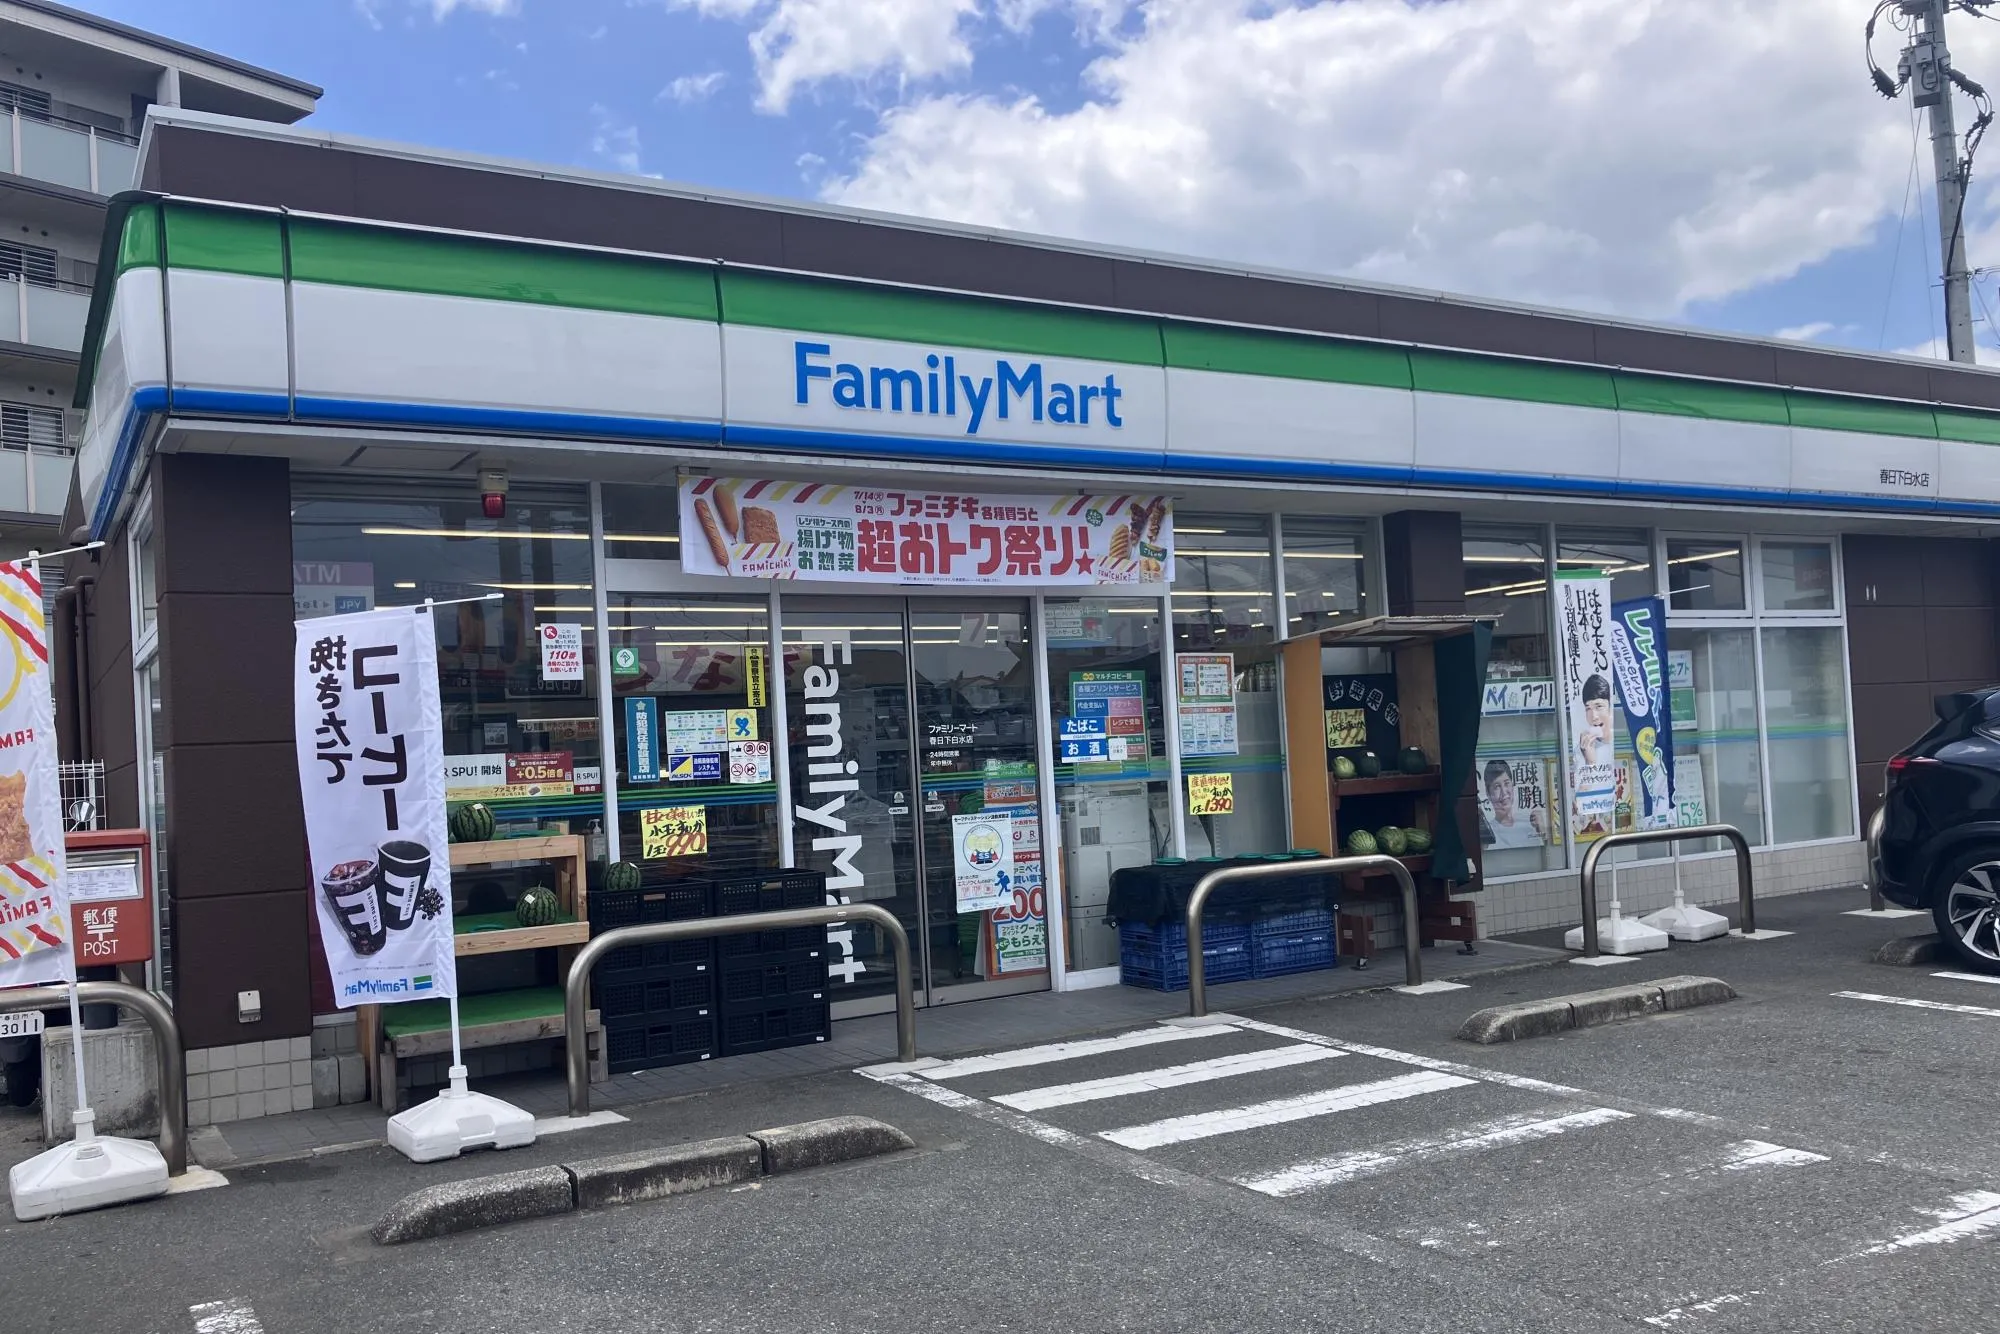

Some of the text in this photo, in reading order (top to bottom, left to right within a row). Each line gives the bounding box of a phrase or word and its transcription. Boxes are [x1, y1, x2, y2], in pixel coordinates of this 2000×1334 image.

[794, 341, 1123, 434] FamilyMart
[1880, 469, 1930, 488] 春日下白水店
[887, 492, 1038, 522] ファミチキ 各種買うと
[797, 529, 854, 550] 揚げ物
[798, 551, 854, 571] お惣菜
[340, 600, 361, 609] JPY
[550, 651, 576, 659] 110番
[928, 724, 978, 733] ファミリーマート
[1067, 719, 1098, 733] たばこ
[929, 736, 973, 745] 春日下白水店
[452, 766, 477, 777] SPU!
[481, 765, 502, 776] 開始
[1512, 763, 1539, 786] 直球
[1680, 802, 1703, 827] 5%
[666, 832, 705, 857] 990
[83, 907, 118, 925] 郵便
[83, 939, 119, 956] POST
